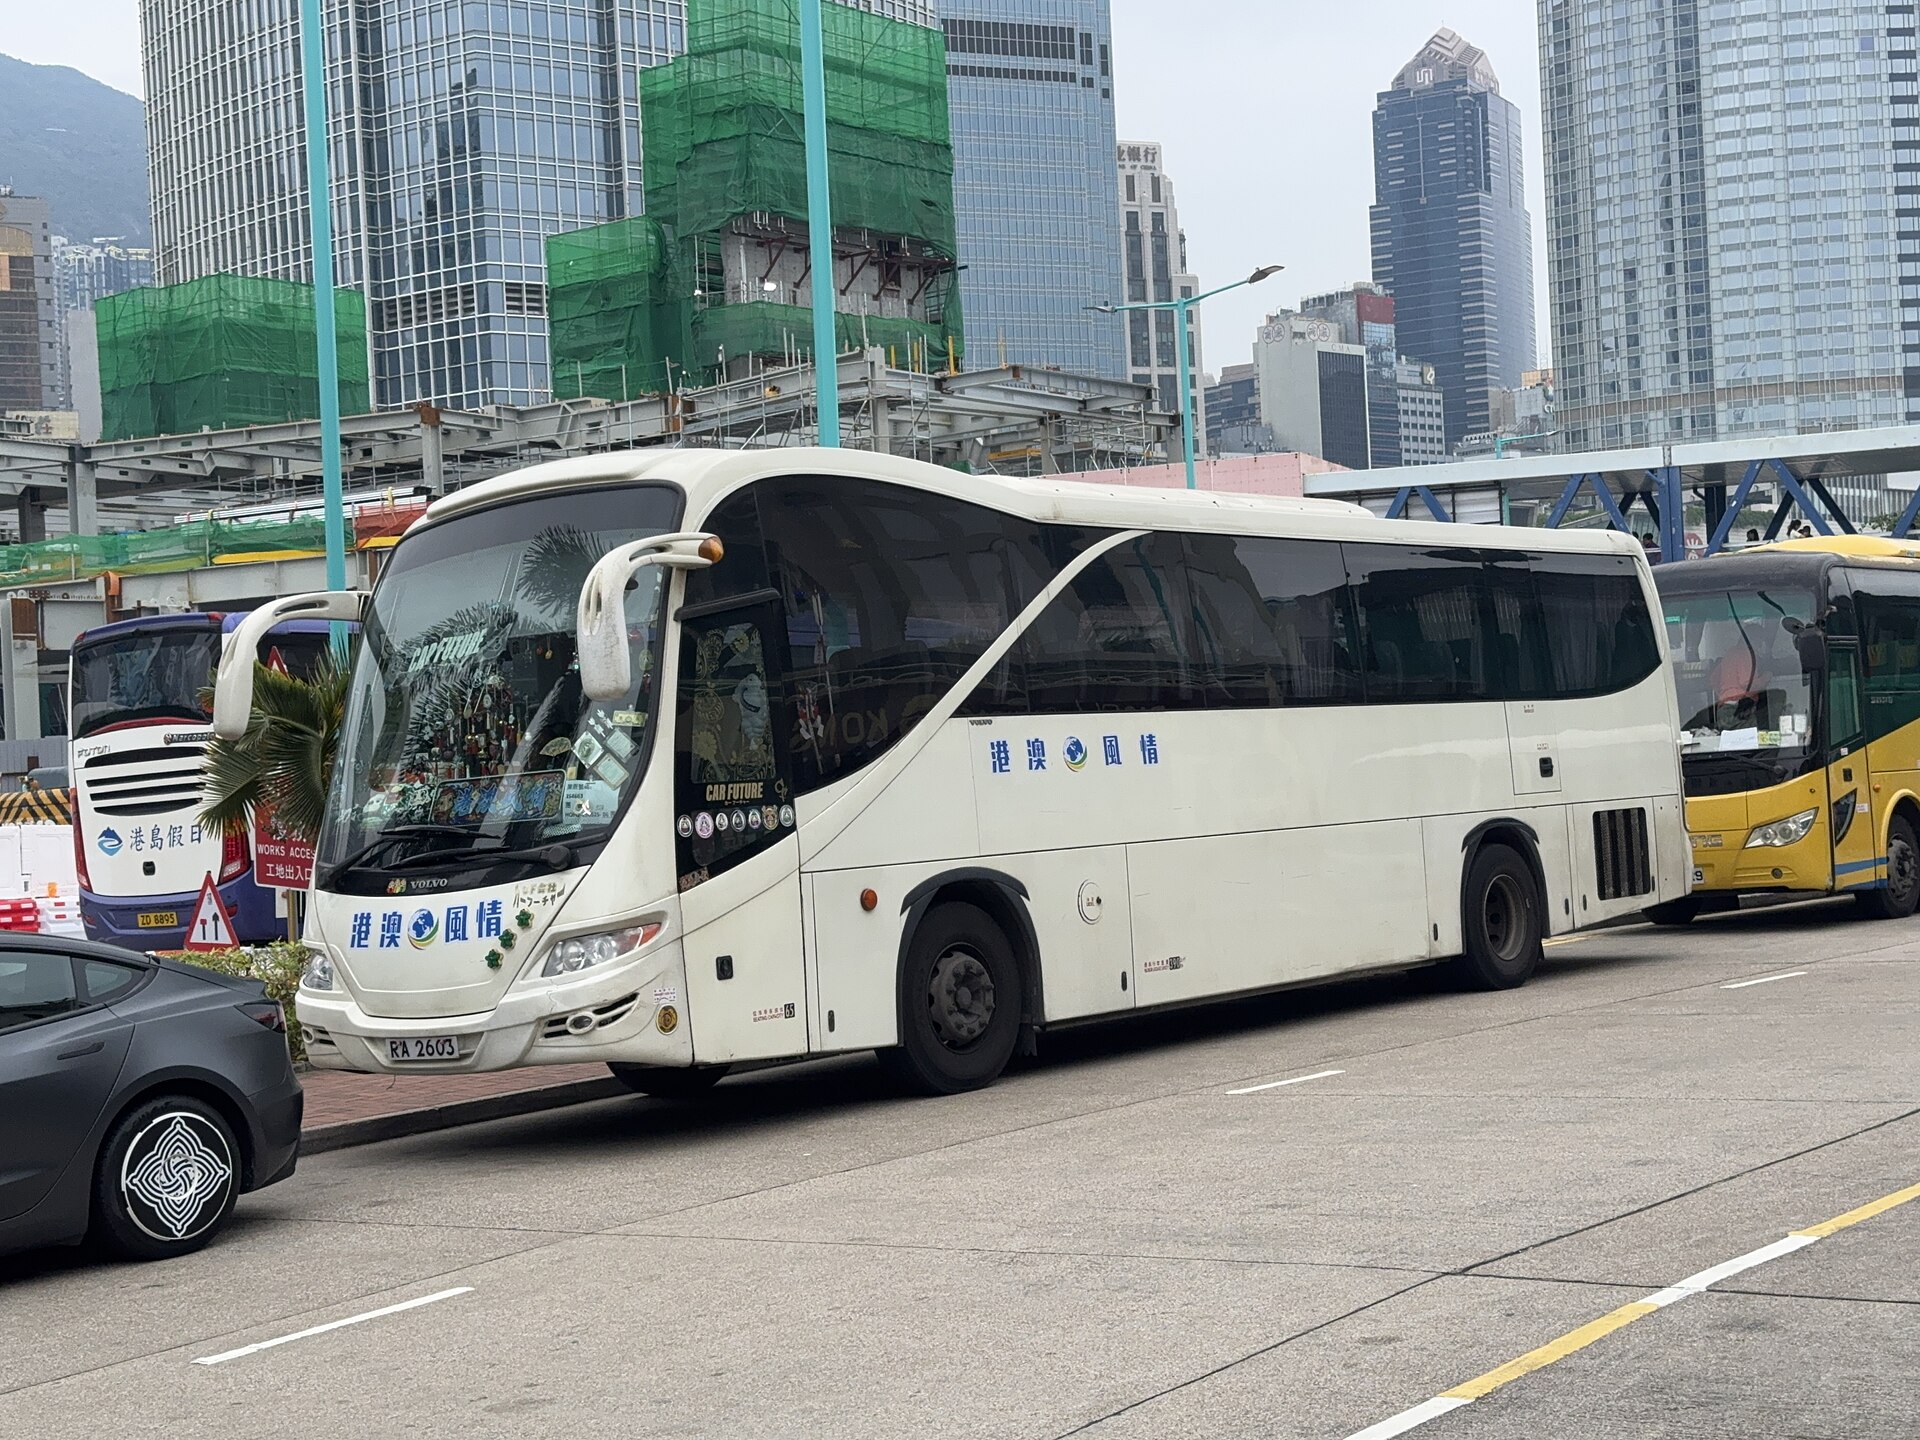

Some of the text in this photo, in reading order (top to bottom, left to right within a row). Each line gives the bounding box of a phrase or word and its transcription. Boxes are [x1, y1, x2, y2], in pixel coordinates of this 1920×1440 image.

[1331, 343, 1351, 353] CMA
[77, 745, 110, 758] FOTON
[706, 784, 726, 801] CAR
[727, 782, 763, 800] FUTURE
[130, 824, 202, 851] 港島假日
[257, 843, 315, 860] WORKS ACCES
[266, 863, 313, 881] 工地出入口
[411, 878, 448, 889] VOLVO
[141, 914, 174, 925] ZD 8895
[785, 1004, 794, 1018] 65
[390, 1039, 454, 1058] RA 2603
